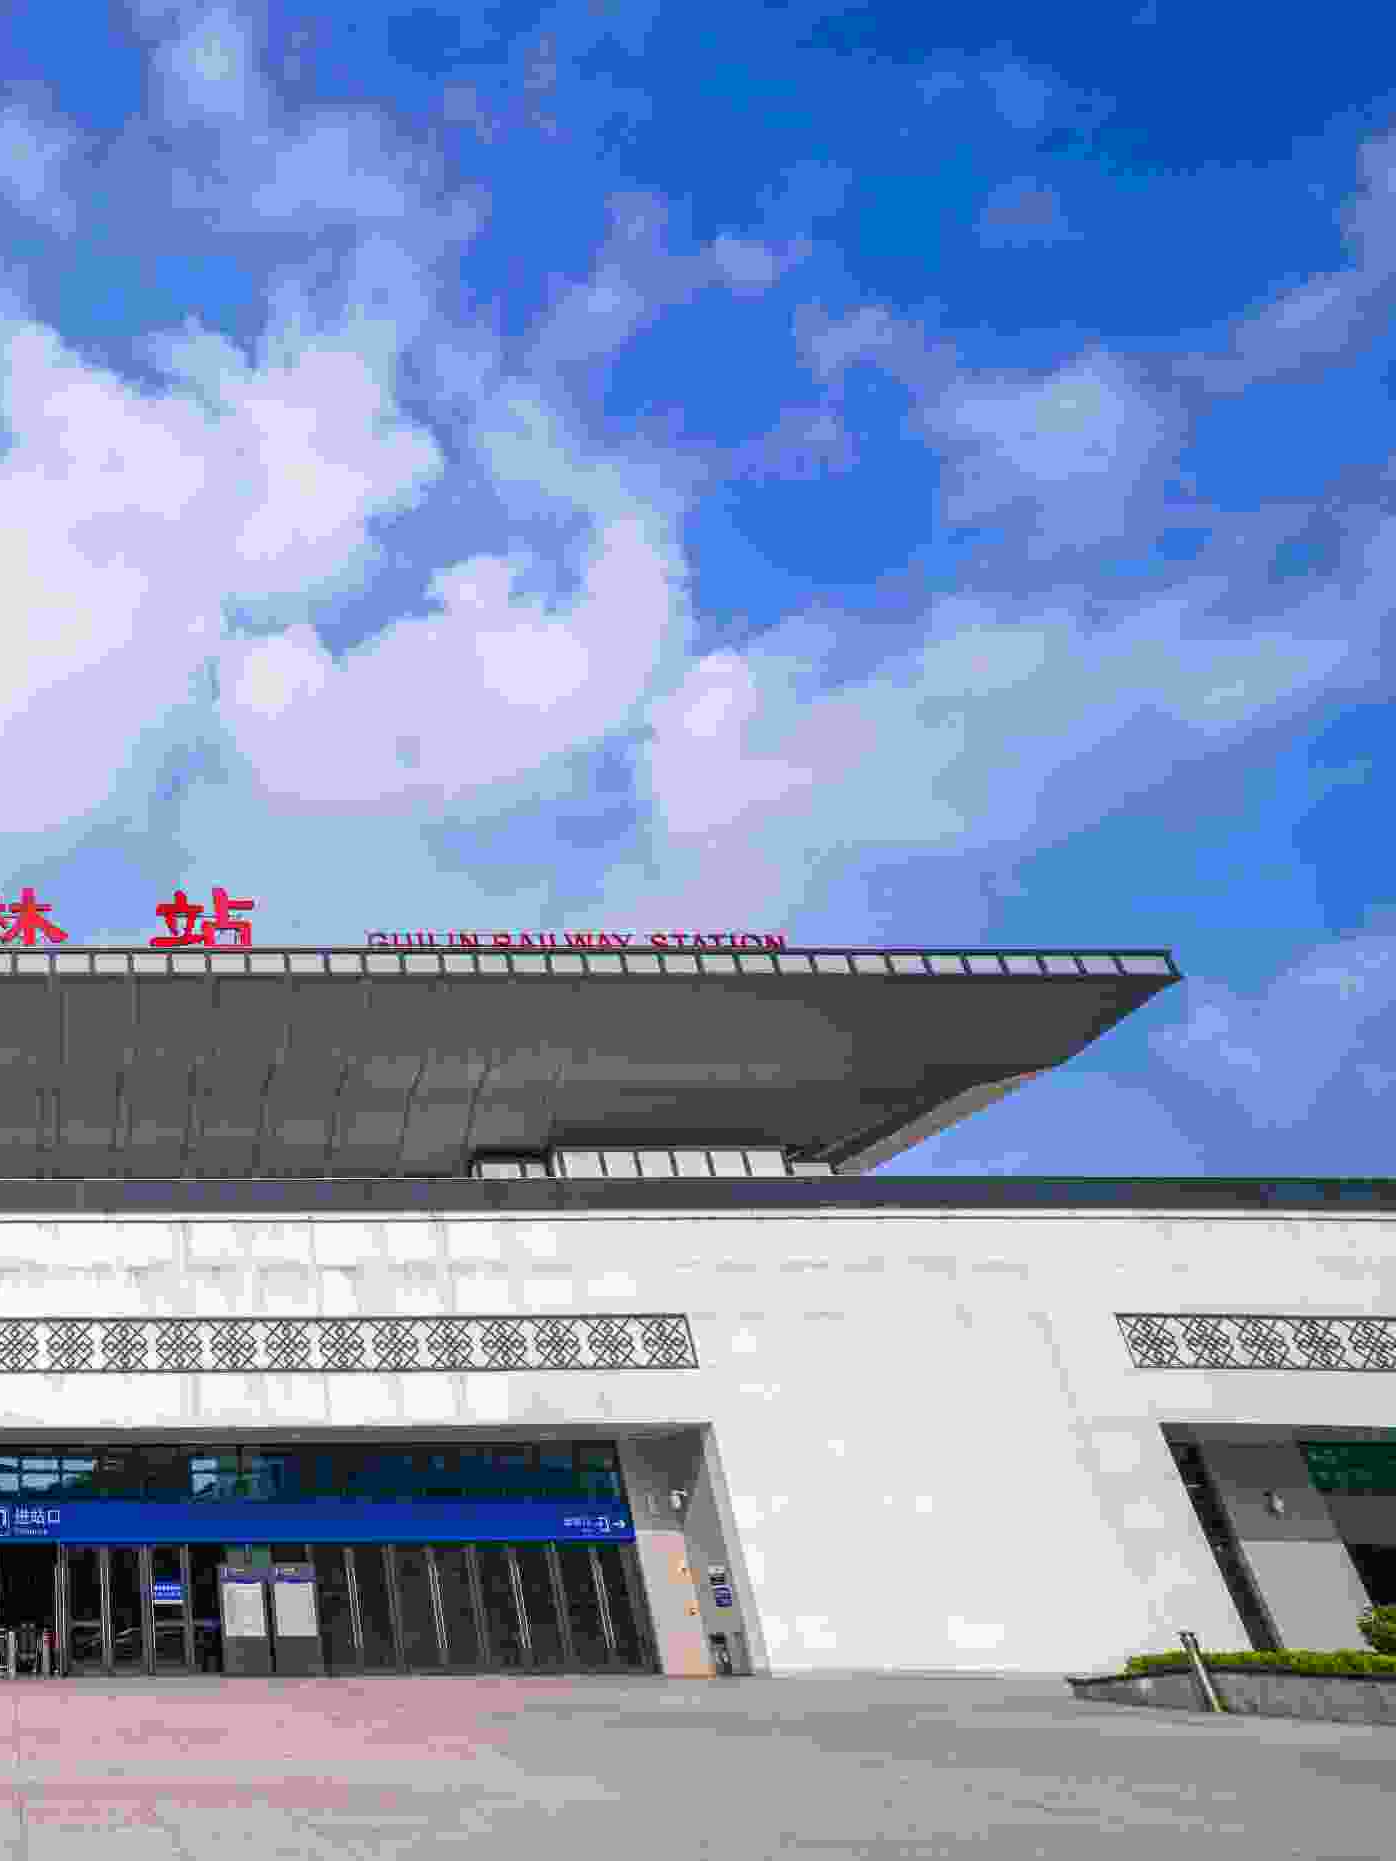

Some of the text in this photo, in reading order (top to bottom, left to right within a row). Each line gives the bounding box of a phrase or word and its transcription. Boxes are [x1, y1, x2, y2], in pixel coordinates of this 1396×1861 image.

[367, 932, 788, 950] GUILIN RAILWAY STATION
